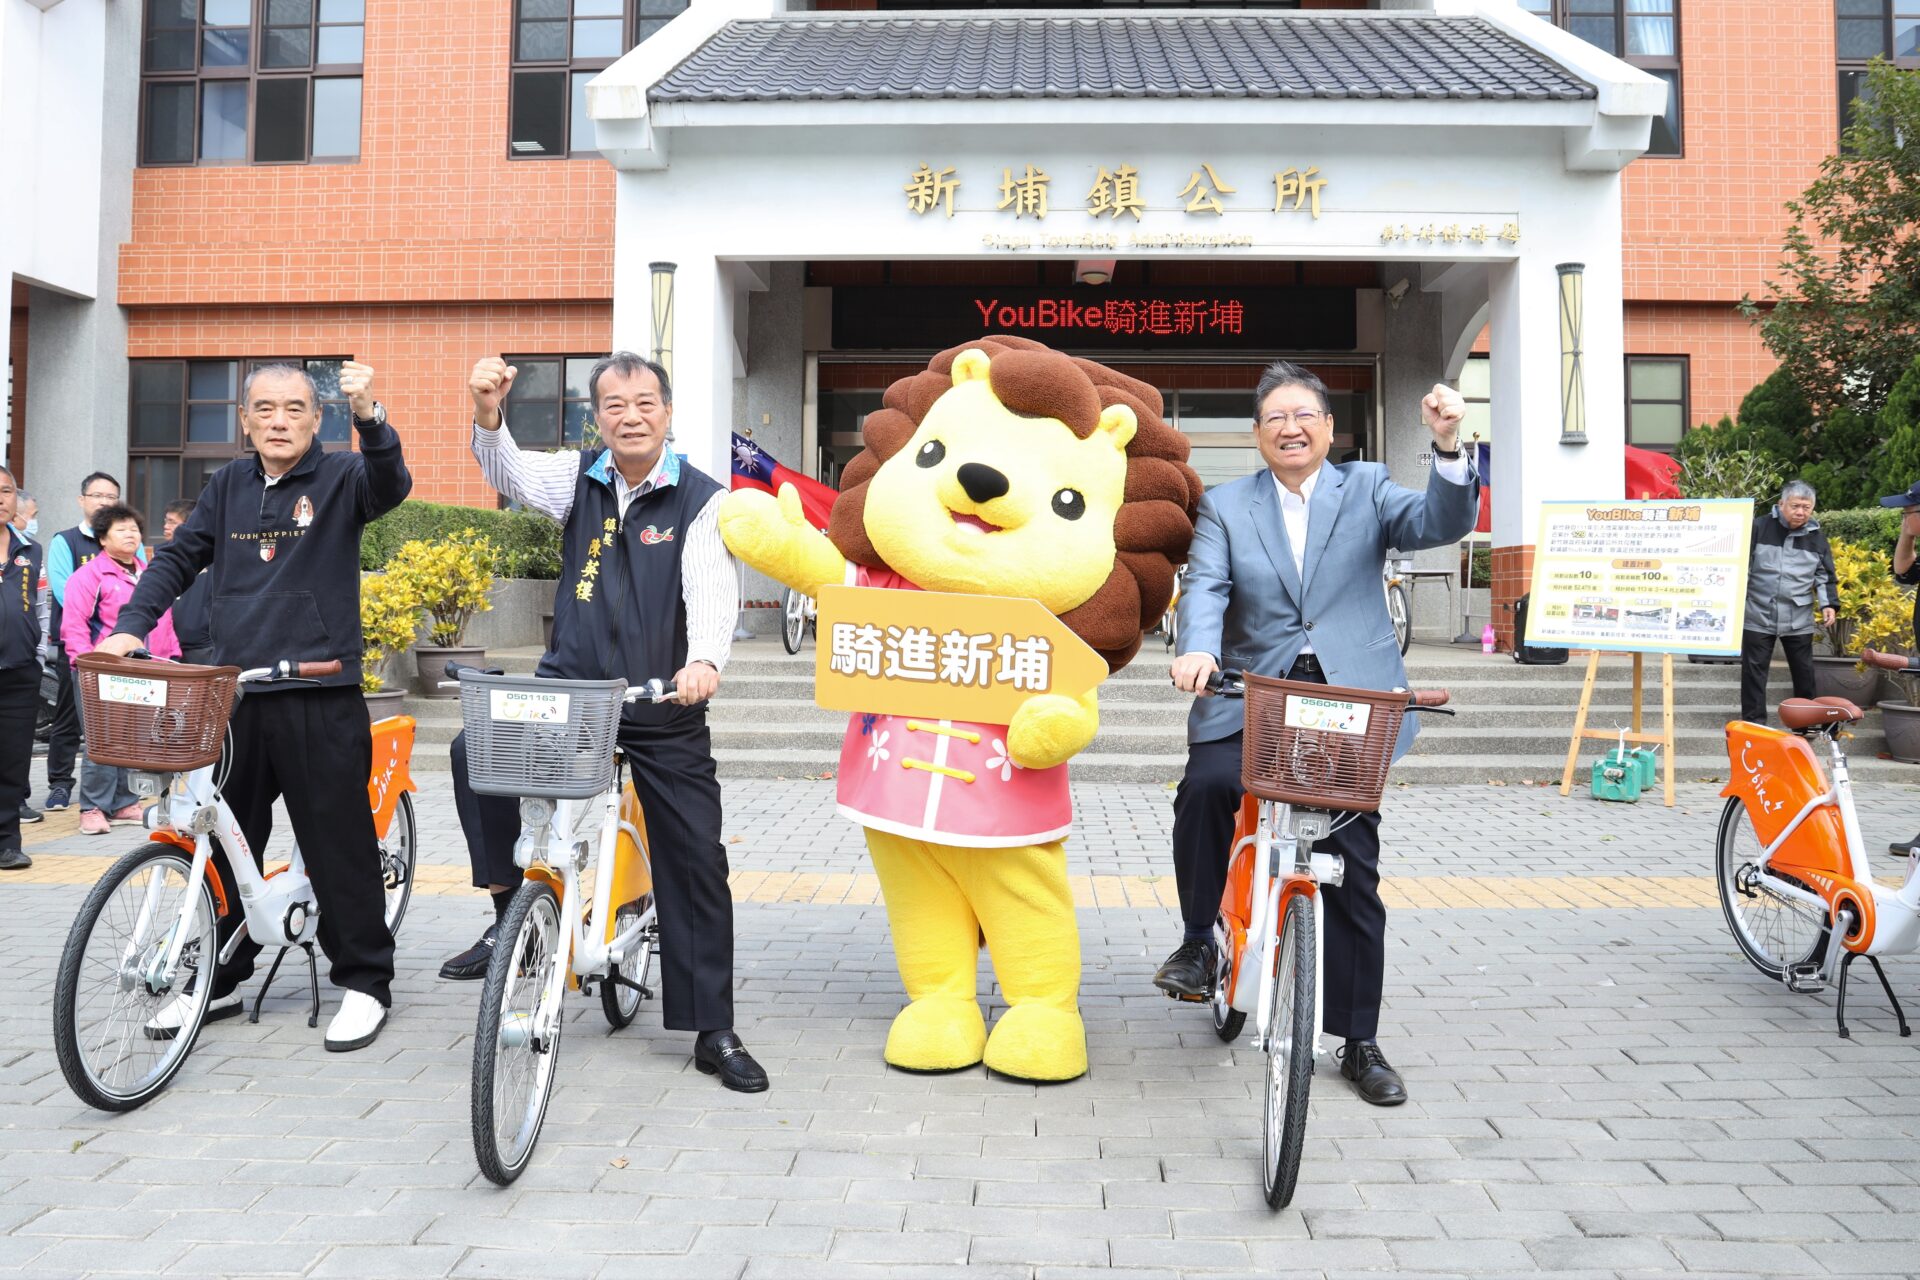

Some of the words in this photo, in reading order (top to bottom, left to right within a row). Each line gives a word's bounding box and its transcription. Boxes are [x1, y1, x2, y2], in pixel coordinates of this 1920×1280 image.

[903, 161, 1328, 220] 新埔鎮公所
[975, 299, 1243, 335] YouBike騎進新埔
[231, 532, 258, 540] HUSH
[603, 518, 617, 547] 鎮長
[829, 621, 1052, 692] 騎進新埔
[110, 676, 152, 686] 0560401
[506, 693, 556, 702] 0501163
[1301, 698, 1353, 710] 0560418
